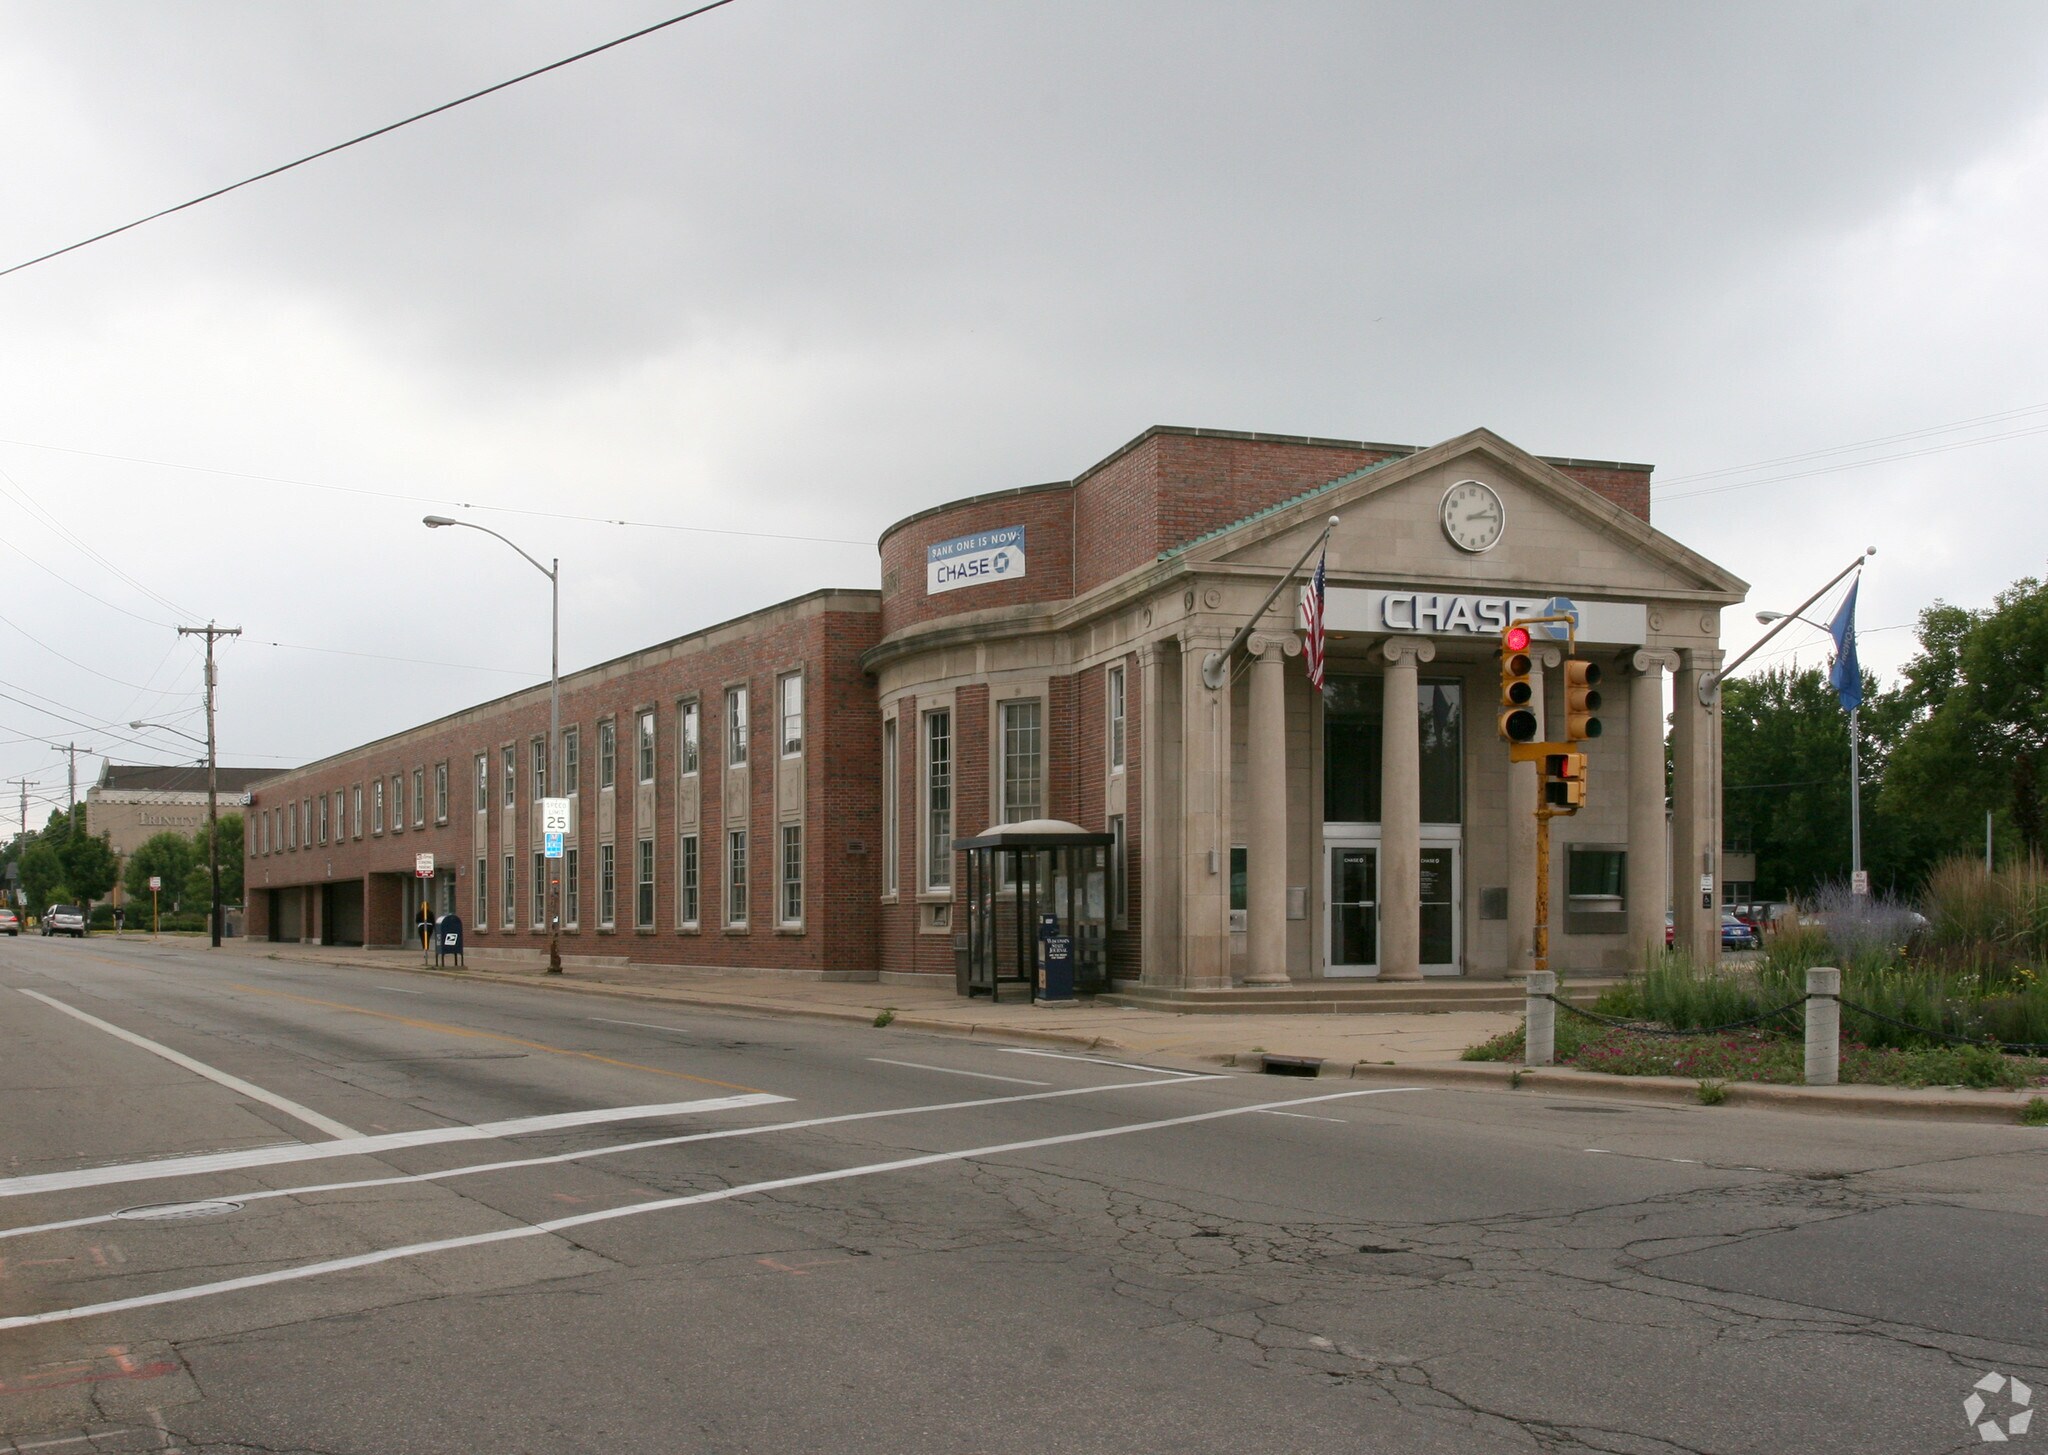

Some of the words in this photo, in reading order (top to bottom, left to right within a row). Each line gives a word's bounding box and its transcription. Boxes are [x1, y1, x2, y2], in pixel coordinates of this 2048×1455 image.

[931, 545, 953, 558] BANK
[956, 540, 975, 551] ONE
[978, 537, 987, 546] IS
[937, 558, 990, 583] CHASE
[1382, 594, 1534, 634] CHASE
[138, 812, 196, 826] TRINITY
[547, 816, 566, 829] 25
